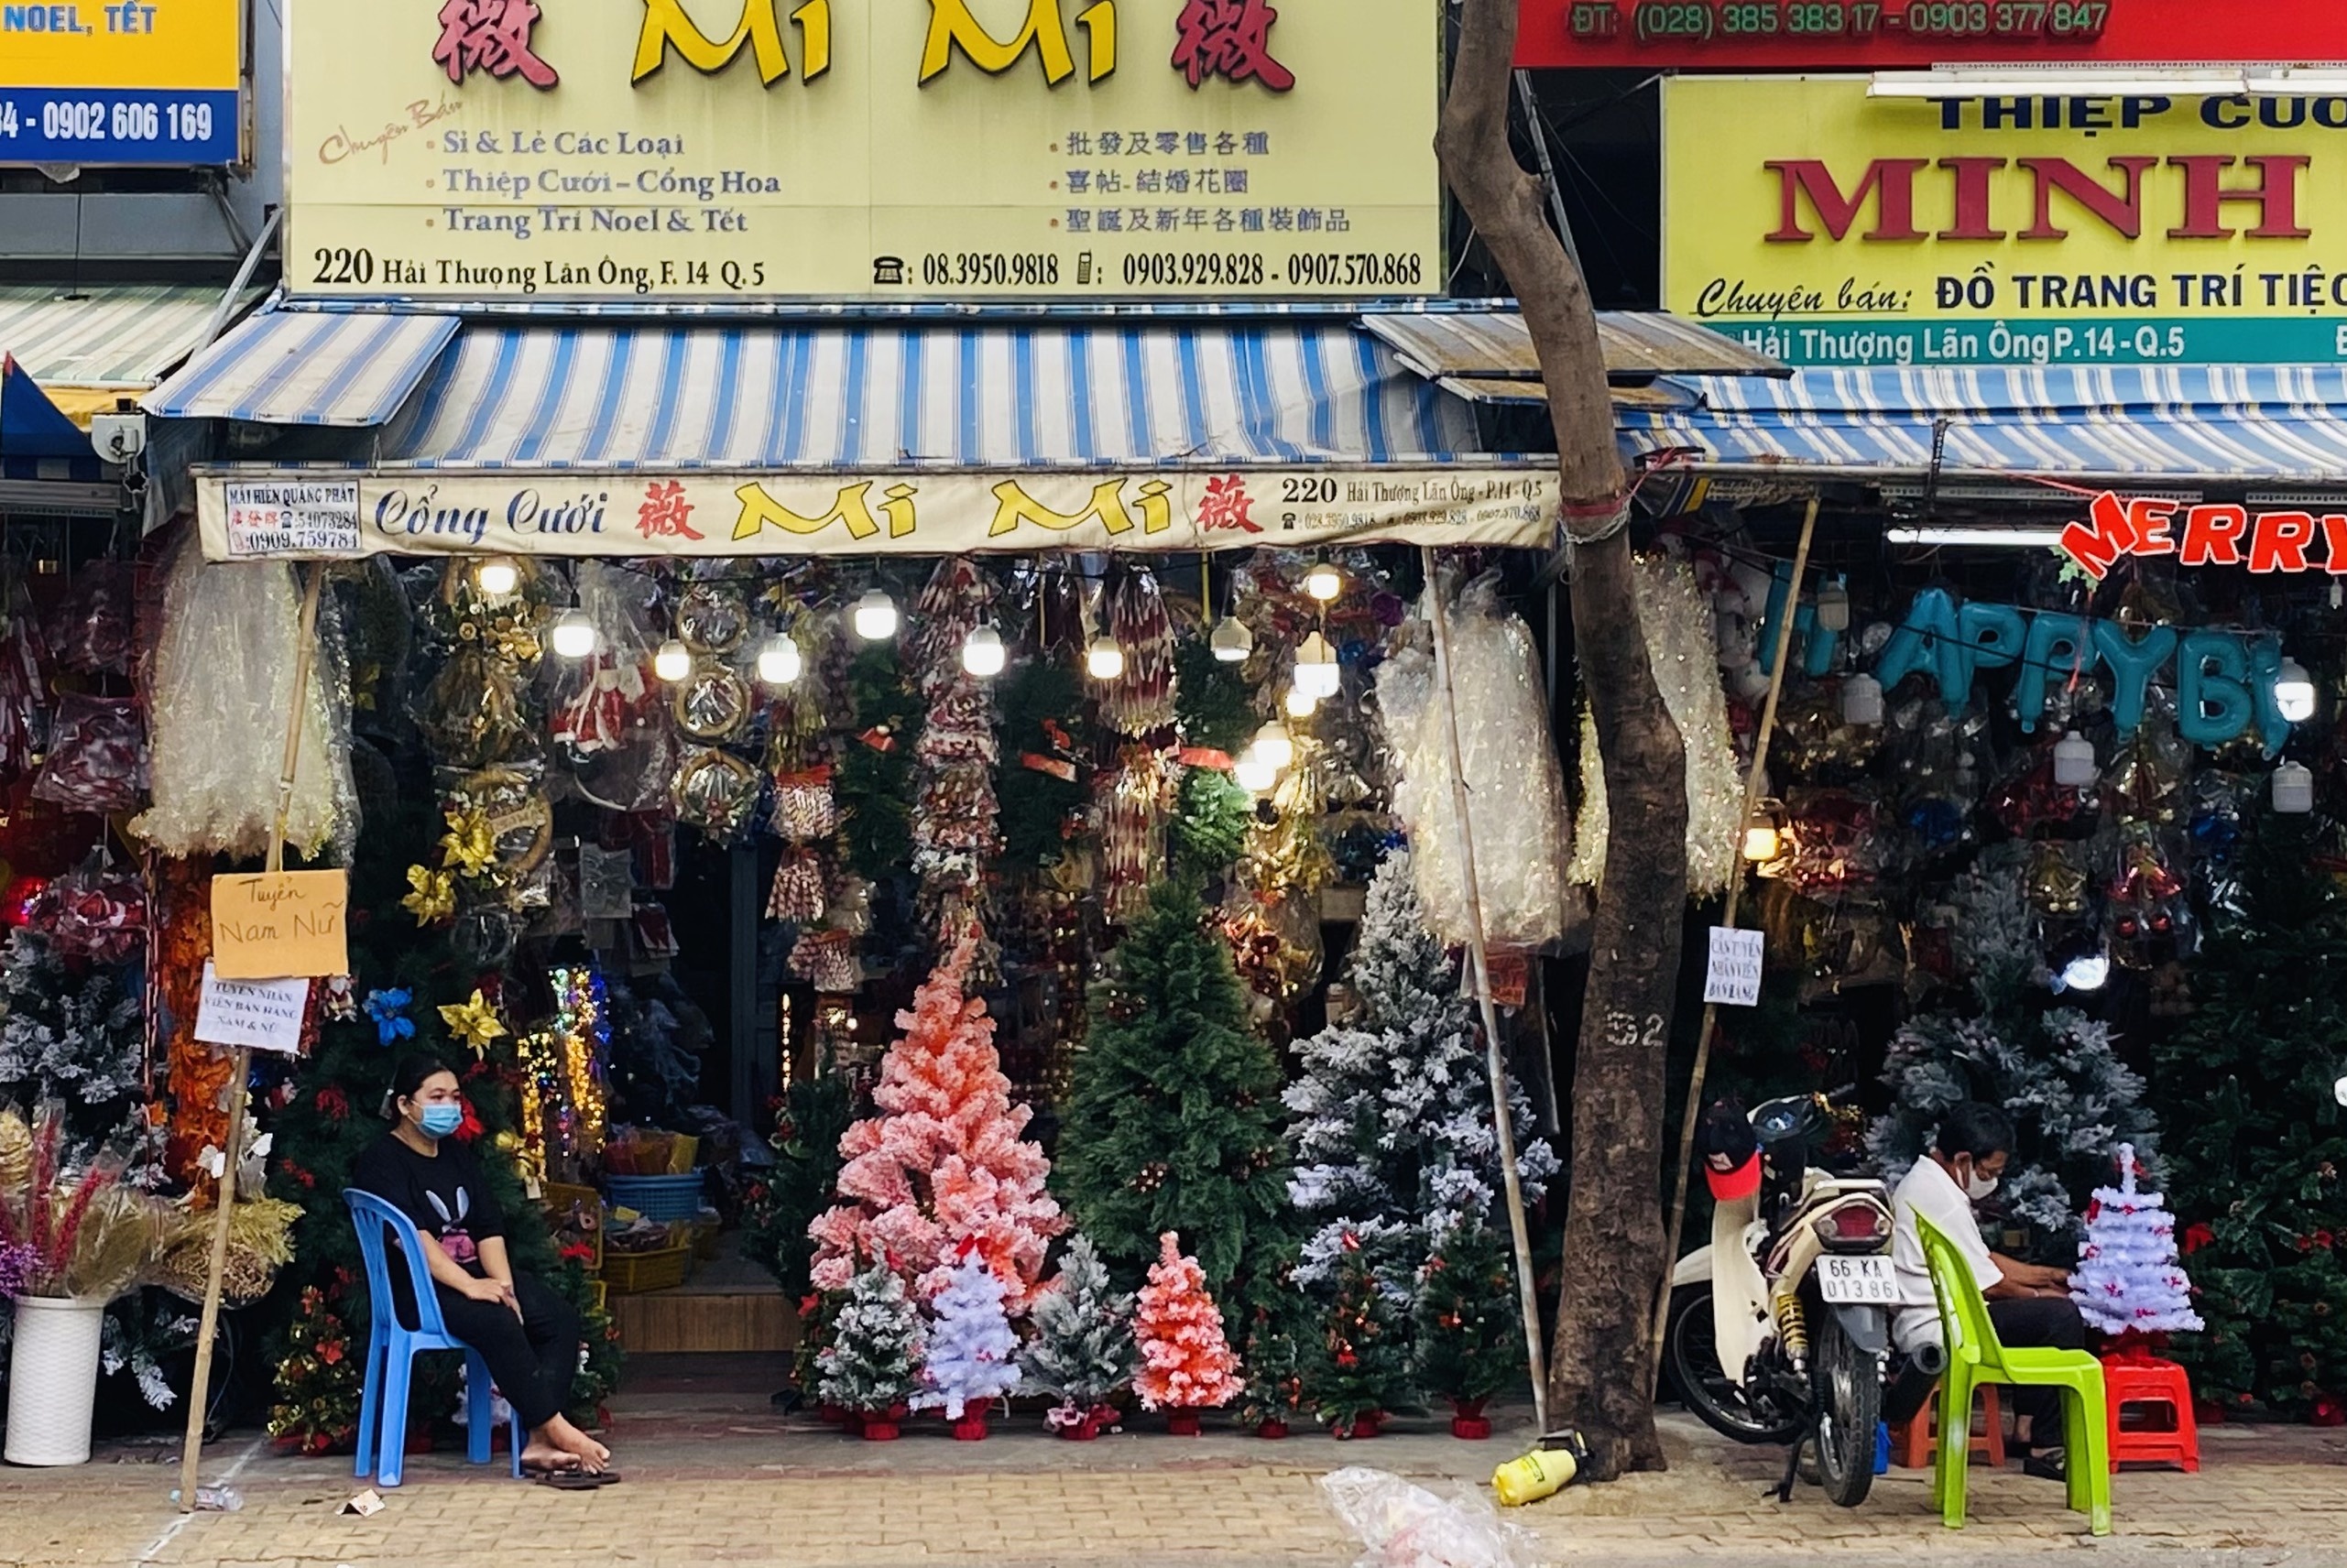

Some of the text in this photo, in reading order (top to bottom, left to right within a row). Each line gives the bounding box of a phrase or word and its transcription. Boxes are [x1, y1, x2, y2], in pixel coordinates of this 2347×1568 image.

[5, 5, 93, 37] NOEL,
[1572, 4, 1619, 34] ĐT:
[1636, 4, 1713, 40] (028)
[1721, 4, 1779, 34] 385
[1787, 4, 1843, 34] 383
[1851, 3, 1879, 32] 17
[1909, 3, 1989, 33] 0903
[1995, 3, 2046, 32] 377
[2053, 3, 2107, 32] 847
[631, 0, 832, 89] Mi
[917, 0, 1117, 89] Mi
[43, 102, 105, 140] 0902
[112, 102, 158, 141] 606
[166, 103, 213, 141] 169
[319, 89, 464, 165] Chuyên Bán
[476, 130, 503, 154] &
[554, 131, 610, 155] Các
[617, 131, 685, 159] Loại
[1066, 131, 1270, 156] 批發及零售各種
[442, 169, 531, 200] Thiệp
[720, 170, 781, 193] Hoa
[1764, 156, 2310, 243] MINH
[442, 206, 749, 240] Trang Trí Noel & Tết
[312, 247, 374, 285] 220
[383, 258, 427, 285] Hải
[660, 260, 678, 286] F.
[686, 260, 710, 286] 14
[923, 253, 1059, 286] 08.3950.9818
[1123, 253, 1264, 286] 0903.929.828
[1288, 253, 1422, 287] 0907.570.868
[1696, 277, 1825, 321] Chuyên
[1837, 276, 1913, 312] bán:
[1935, 260, 1995, 310] ĐỒ
[2011, 274, 2157, 309] TRANG
[2171, 263, 2247, 308] TRÍ
[1742, 325, 1791, 360] Hải
[1799, 328, 1914, 366] Thượng
[1924, 326, 1979, 359] Lãn
[988, 476, 1174, 539] Mi
[1283, 477, 1337, 503] 220
[1347, 480, 1370, 503] Hải
[1372, 481, 1420, 505] Thượng
[1451, 475, 1476, 504] Ông
[375, 484, 609, 546] Cổng Cưới
[732, 481, 919, 541] Mi
[218, 900, 344, 944] Nam Nữ
